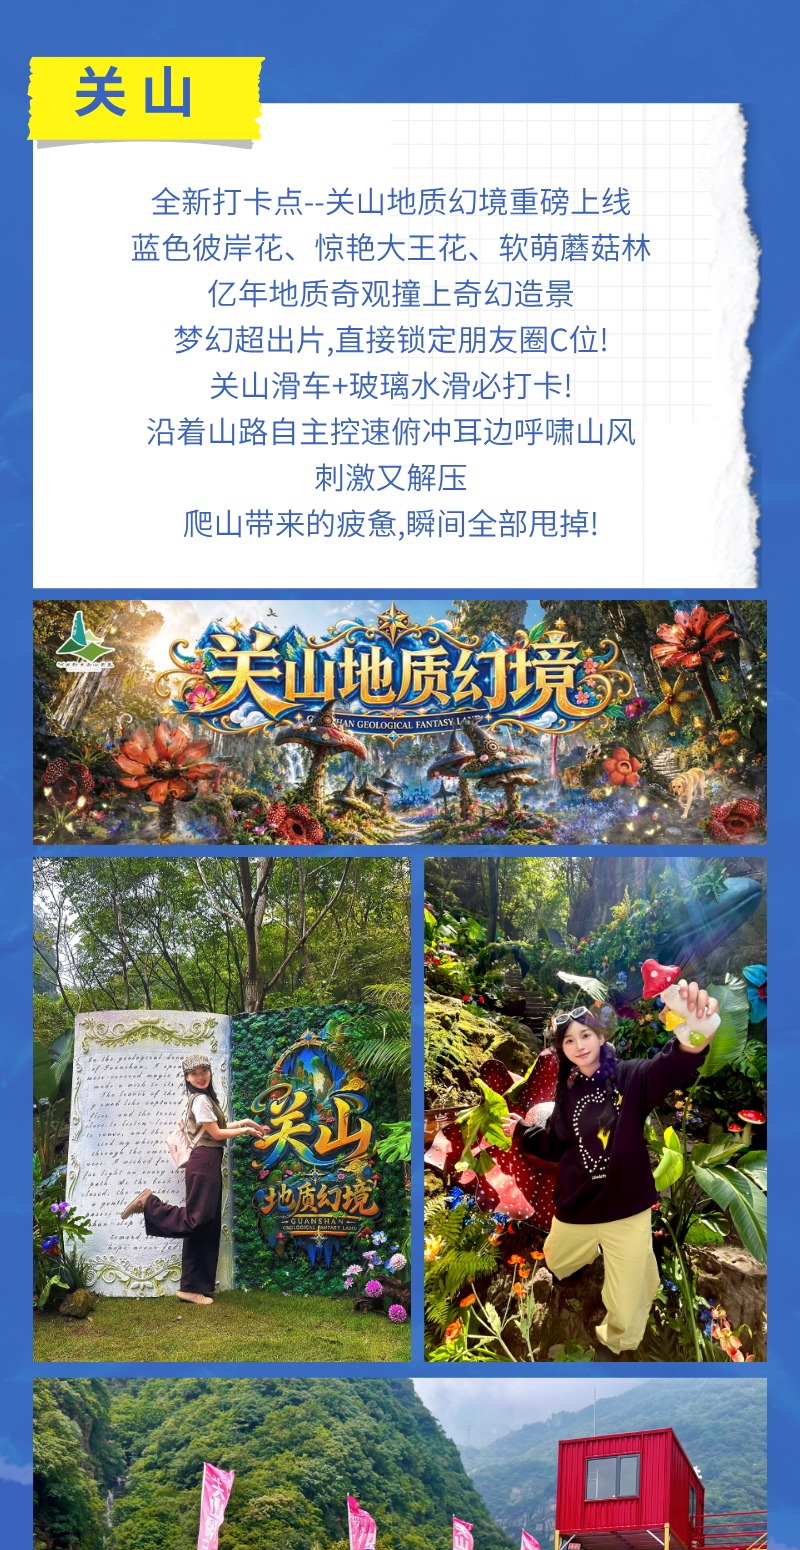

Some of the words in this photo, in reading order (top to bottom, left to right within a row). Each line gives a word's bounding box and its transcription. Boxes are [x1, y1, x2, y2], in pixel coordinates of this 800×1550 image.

[205, 629, 606, 720] 关山地质幻境
[357, 721, 413, 730] GEOLOGICAL
[416, 717, 454, 728] FANTASY
[253, 1091, 373, 1168] 关山
[261, 1179, 379, 1217] 地质幻境
